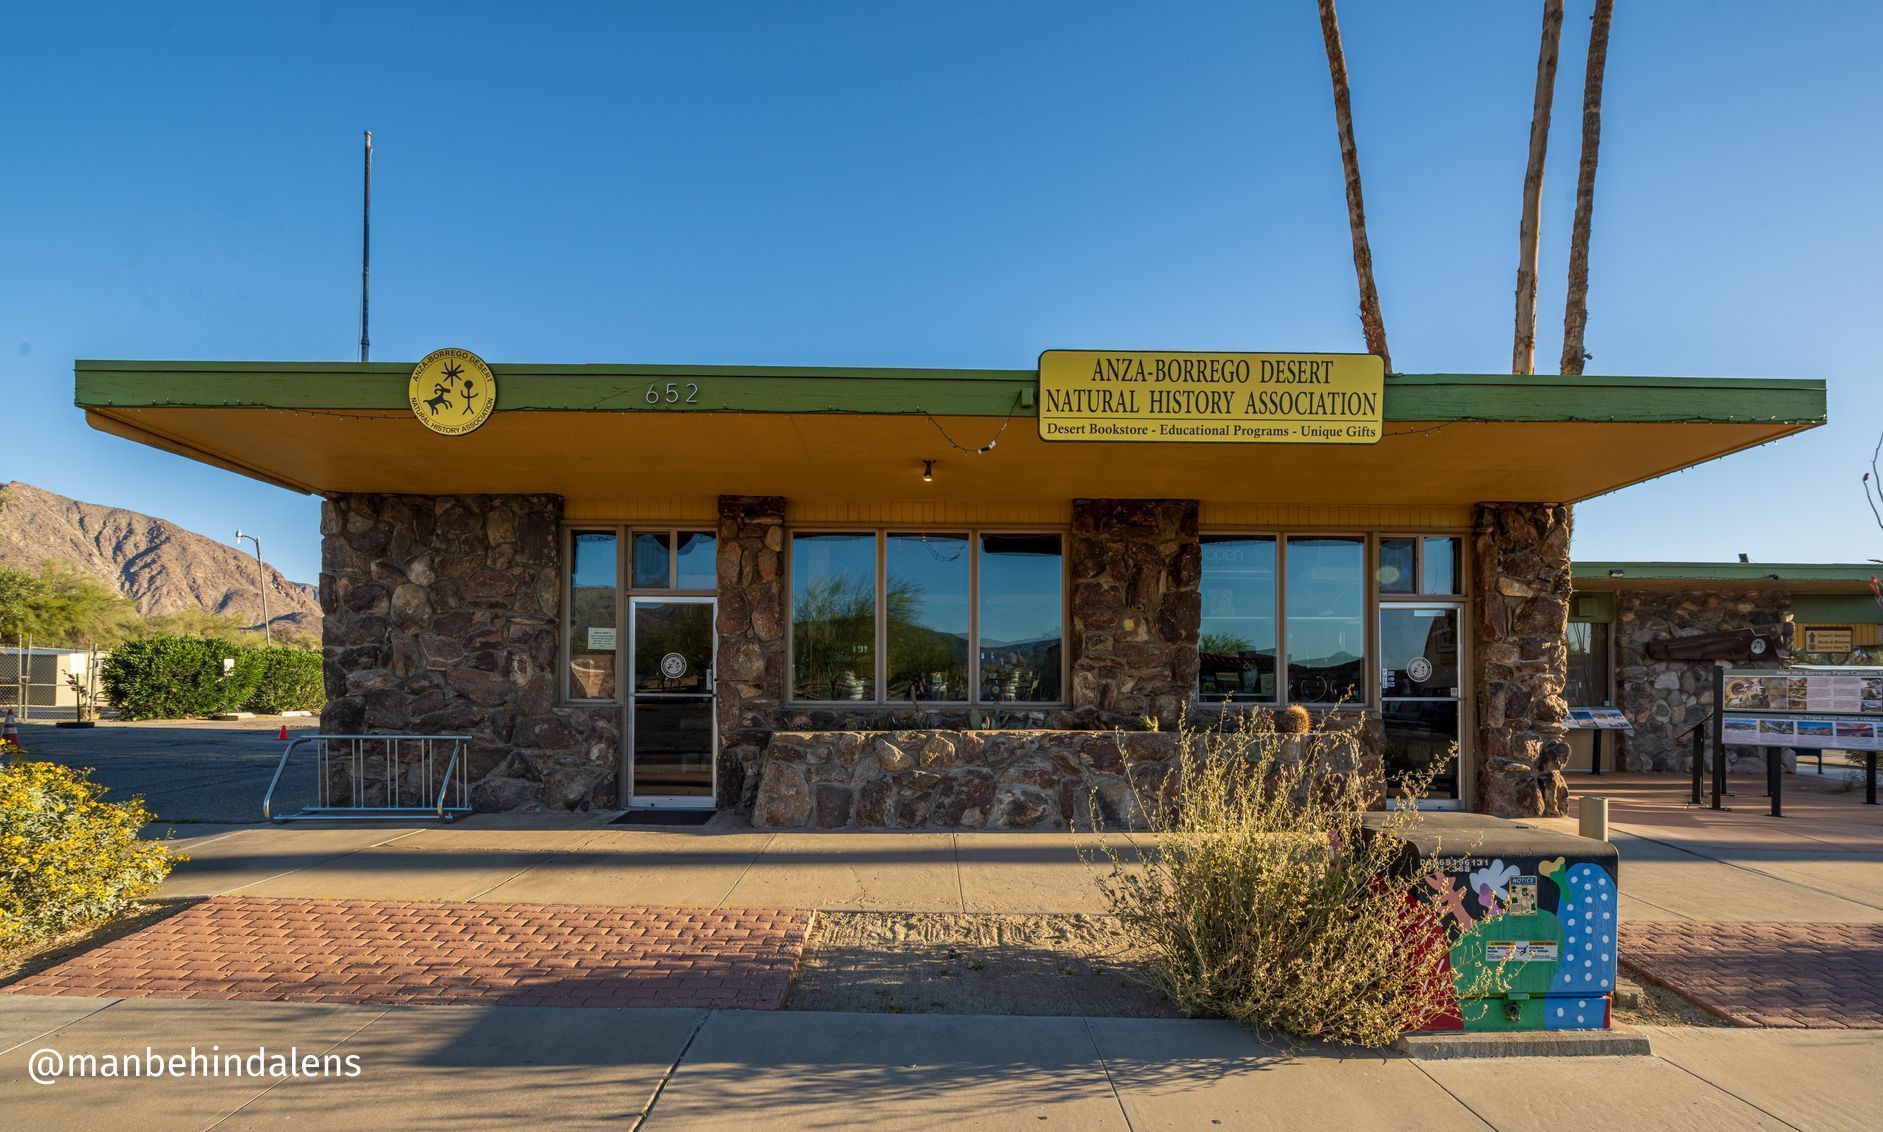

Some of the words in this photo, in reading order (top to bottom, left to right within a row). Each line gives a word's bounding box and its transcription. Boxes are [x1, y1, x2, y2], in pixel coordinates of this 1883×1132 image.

[412, 350, 468, 382] ANZA-BORREGO
[468, 356, 494, 382] DESERT
[1092, 358, 1250, 384] ANZA-BORREGO
[1260, 360, 1334, 384] DESERT
[646, 383, 698, 404] 652
[1046, 388, 1140, 414] NATURAL
[1149, 390, 1236, 414] HISTORY
[1244, 391, 1377, 416] ASSOCIATION
[411, 397, 430, 426] NATURAL
[430, 422, 460, 434] HISTORY
[461, 398, 494, 432] ASSOCIATION
[1046, 423, 1085, 434] Desert
[1090, 424, 1148, 436] Bookstore
[1160, 424, 1230, 436] Educational
[1234, 424, 1289, 438] Programs
[1300, 425, 1343, 439] Unique
[1346, 425, 1376, 437] Gifts
